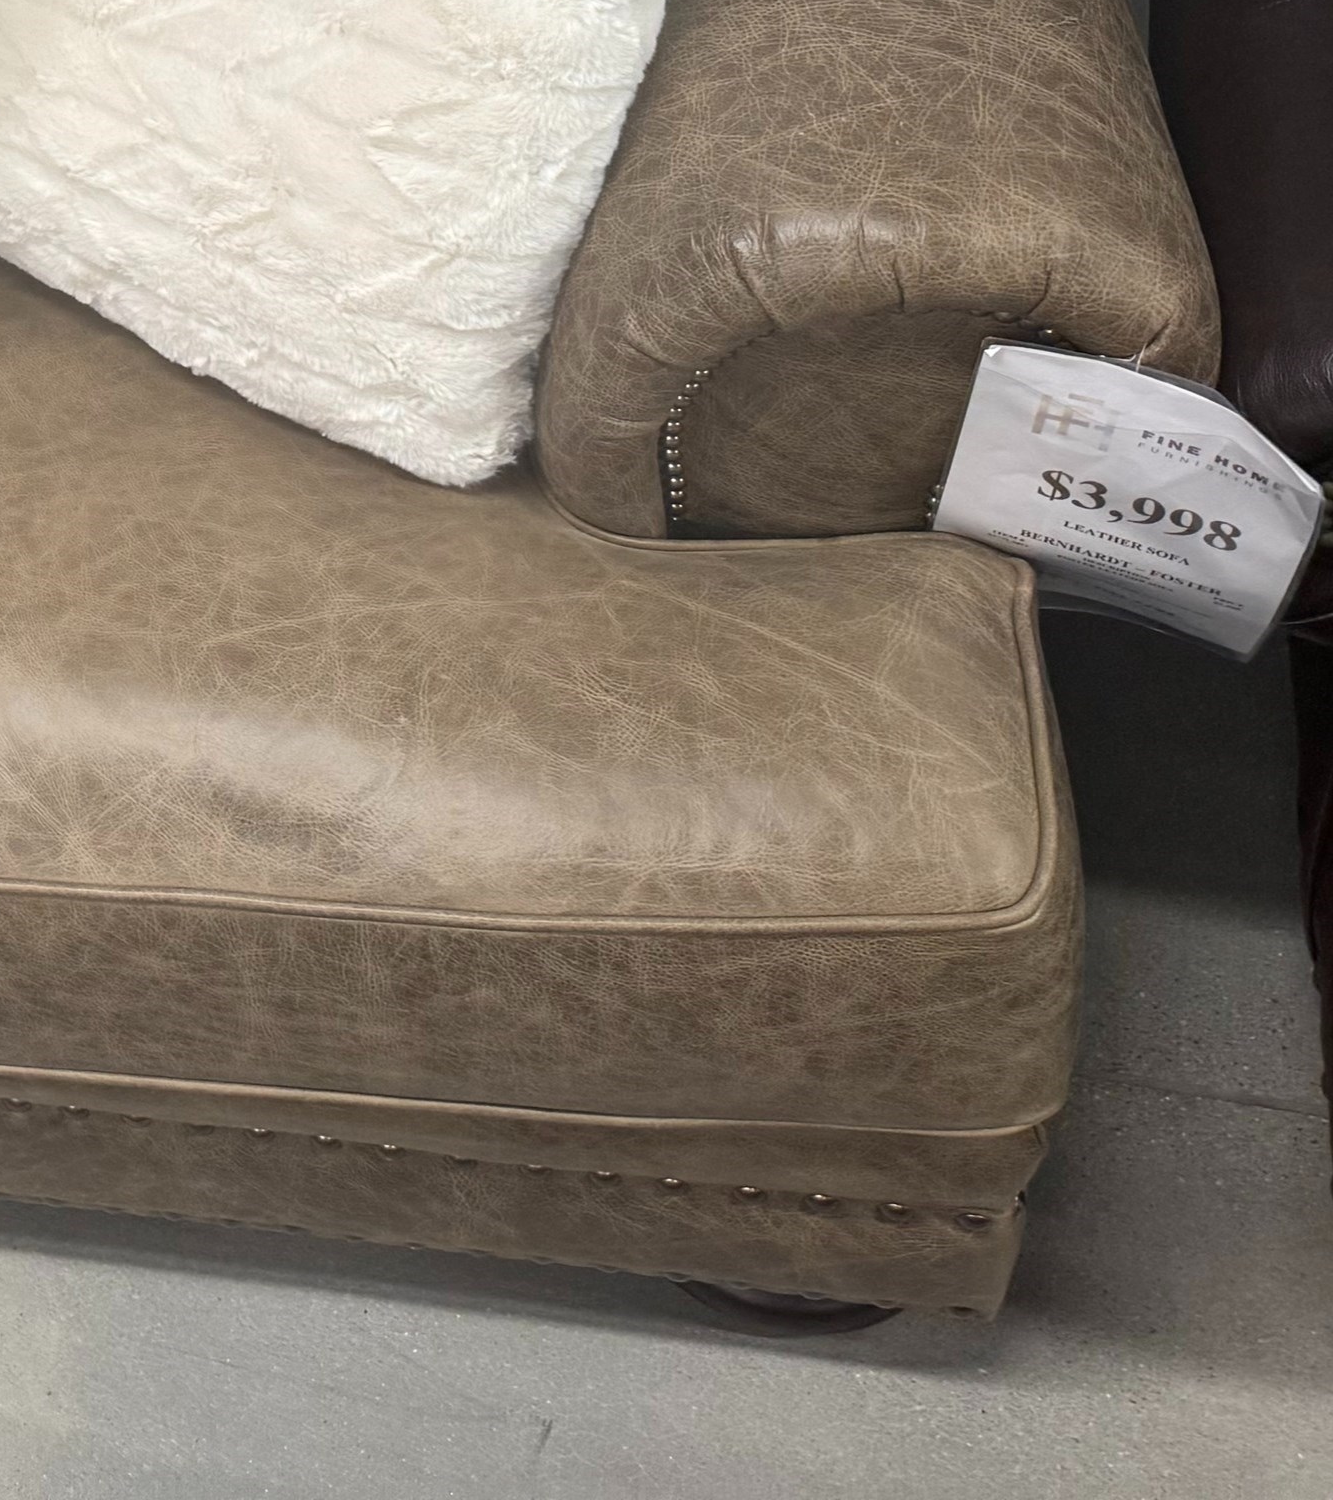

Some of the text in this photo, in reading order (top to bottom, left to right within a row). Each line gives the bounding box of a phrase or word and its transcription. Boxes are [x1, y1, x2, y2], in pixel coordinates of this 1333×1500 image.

[1141, 429, 1286, 492] FINE HOME
[1037, 469, 1242, 551] $3,998
[1020, 529, 1133, 569] BERNHARDT
[1150, 570, 1222, 597] FOSTER
[1063, 520, 1190, 566] LEATHER SOFA
